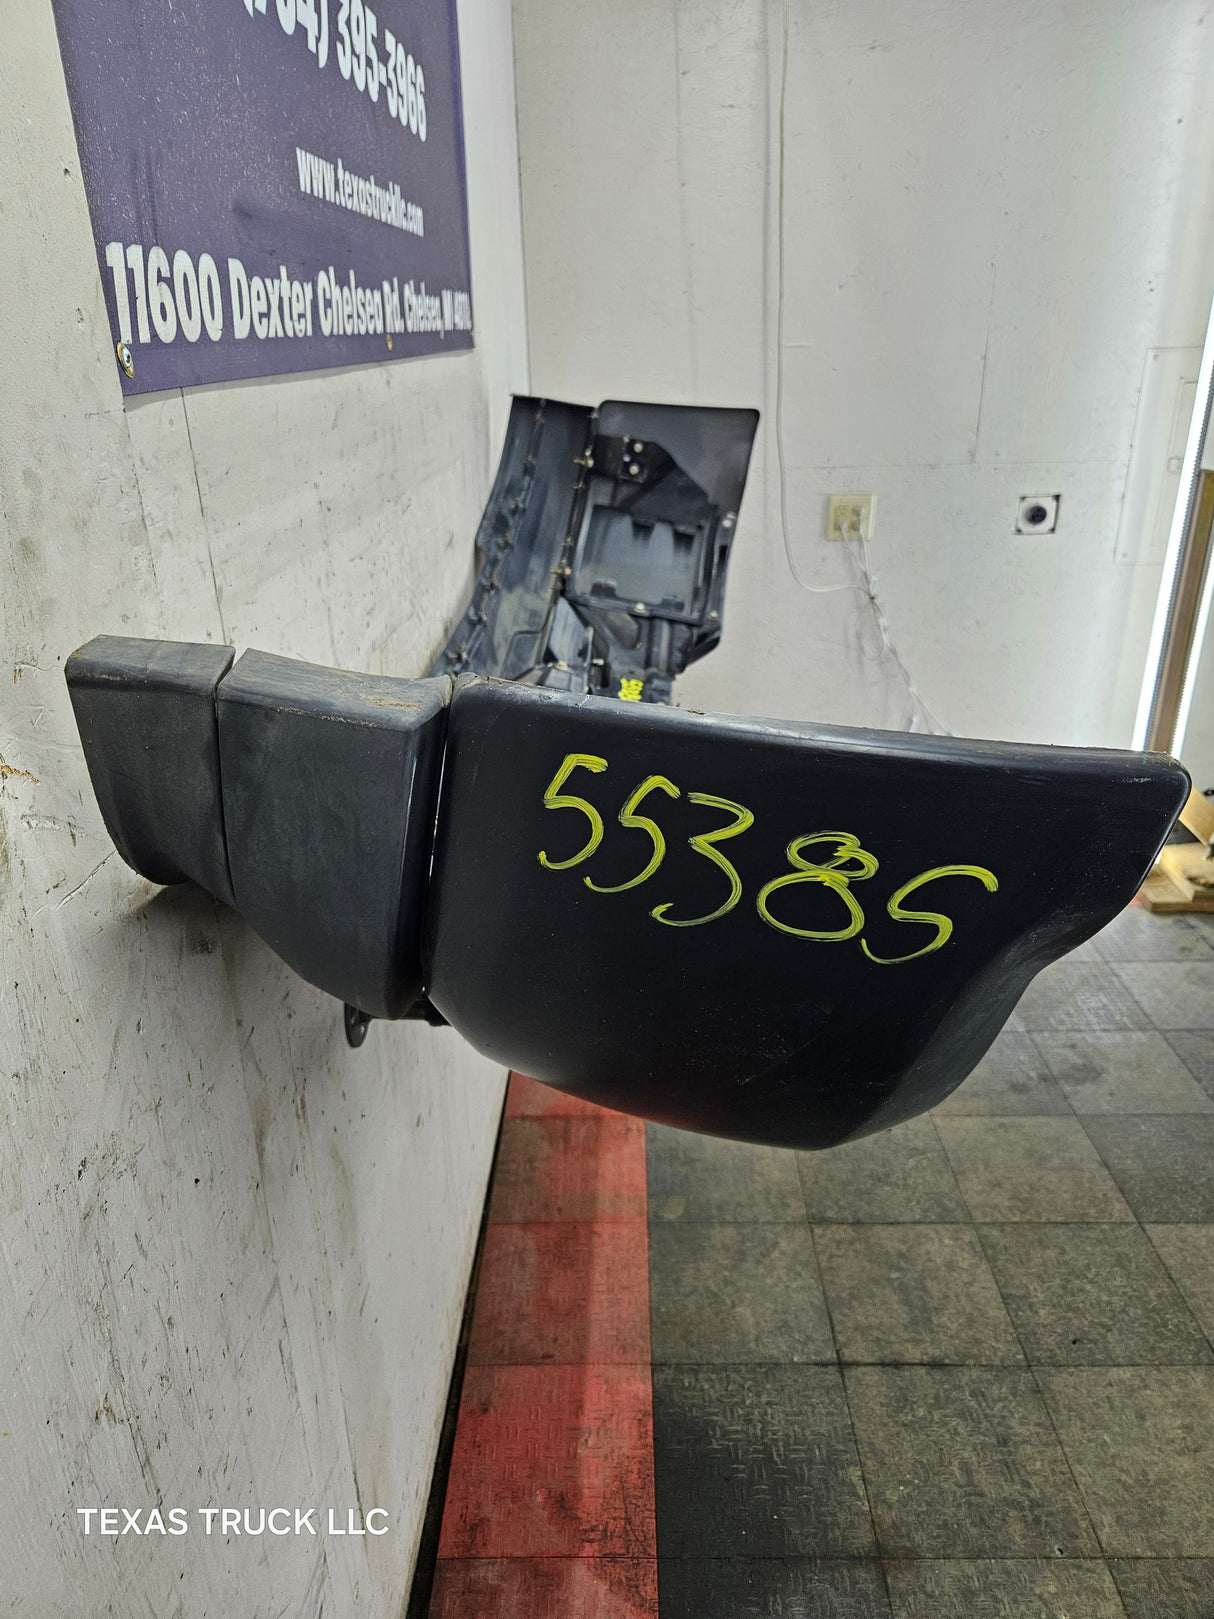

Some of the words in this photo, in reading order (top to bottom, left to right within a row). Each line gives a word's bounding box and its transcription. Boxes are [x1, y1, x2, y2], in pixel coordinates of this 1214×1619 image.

[336, 0, 427, 142] 395-3966
[105, 242, 223, 344] 11600
[227, 257, 313, 340] Dexter
[317, 265, 384, 336] Chelsea
[382, 276, 405, 334] Rd.
[403, 279, 445, 340] Chelsea,
